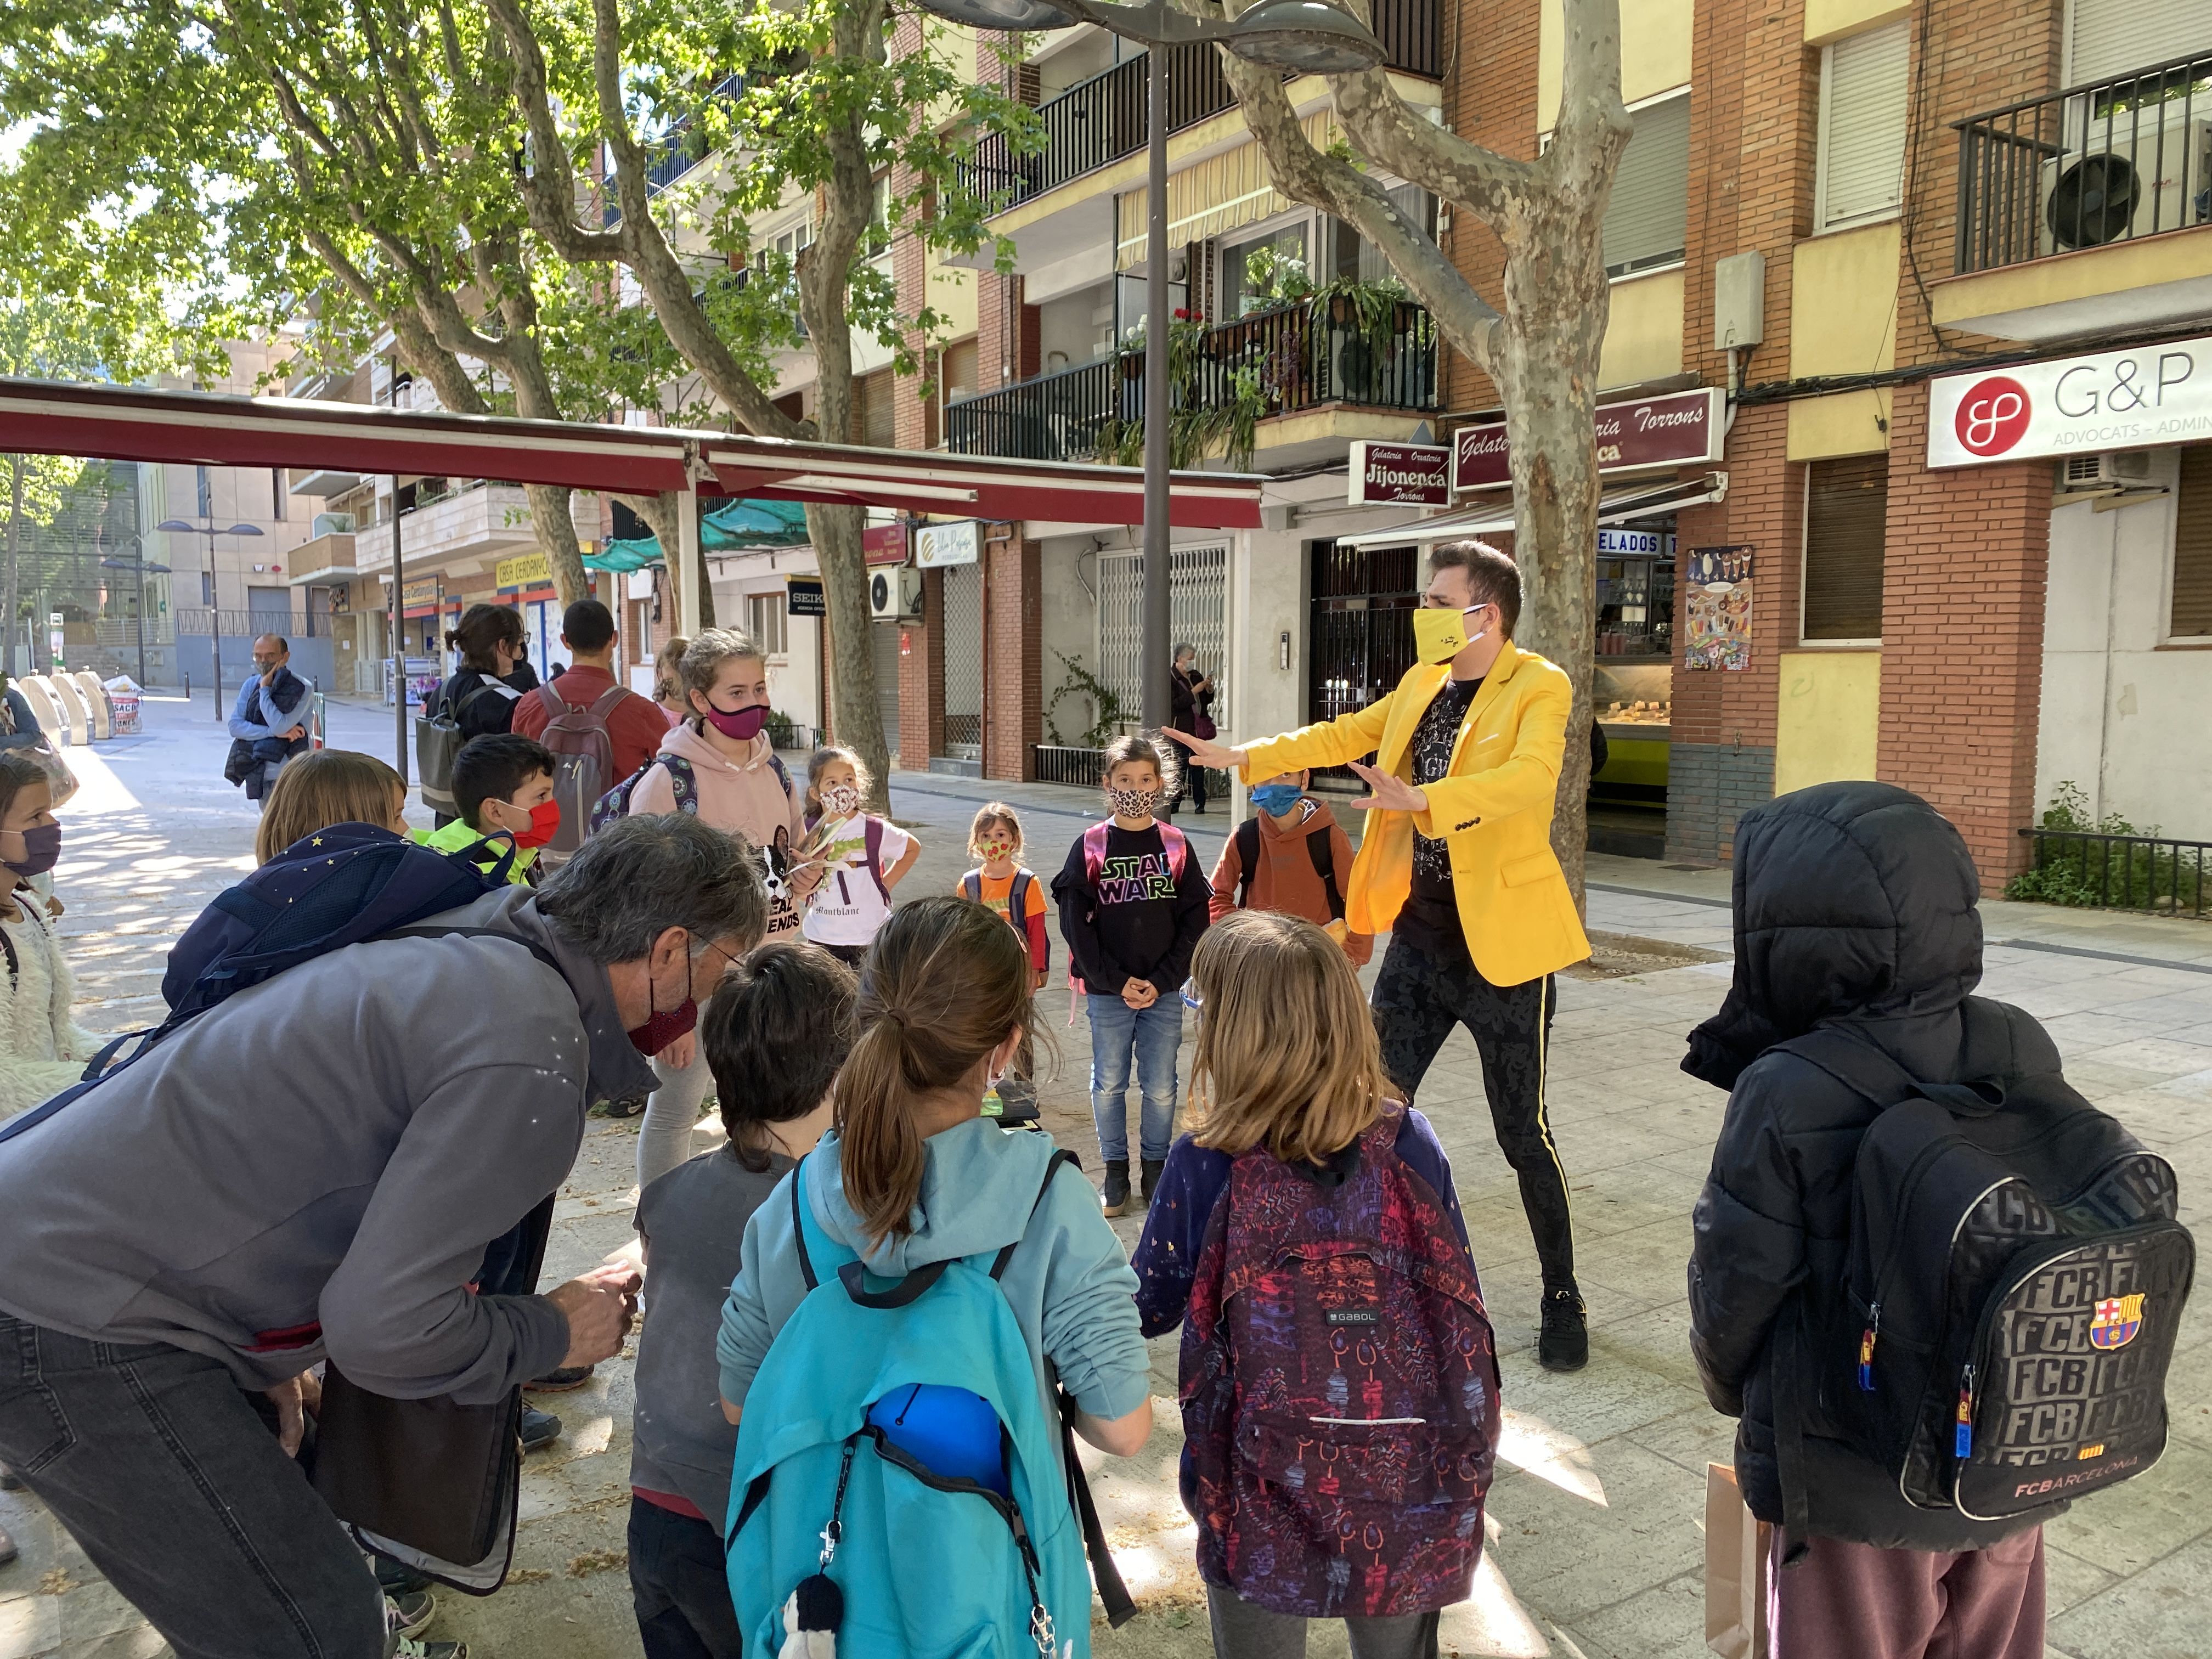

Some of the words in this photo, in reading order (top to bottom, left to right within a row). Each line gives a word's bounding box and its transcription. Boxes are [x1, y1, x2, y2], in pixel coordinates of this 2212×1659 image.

[2055, 351, 2194, 418] G&P
[1634, 406, 1705, 433] Torrons
[2053, 424, 2140, 445] ADVOCATS
[1372, 447, 1402, 461] Gelateria
[1365, 464, 1447, 488] Jijonenca
[1393, 487, 1425, 501] Torrons
[1599, 532, 1657, 552] ELADOS
[499, 563, 514, 583] CASA
[816, 906, 860, 916] Montblanc
[2013, 1358, 2088, 1401] FCB
[2004, 1402, 2080, 1445] FCB
